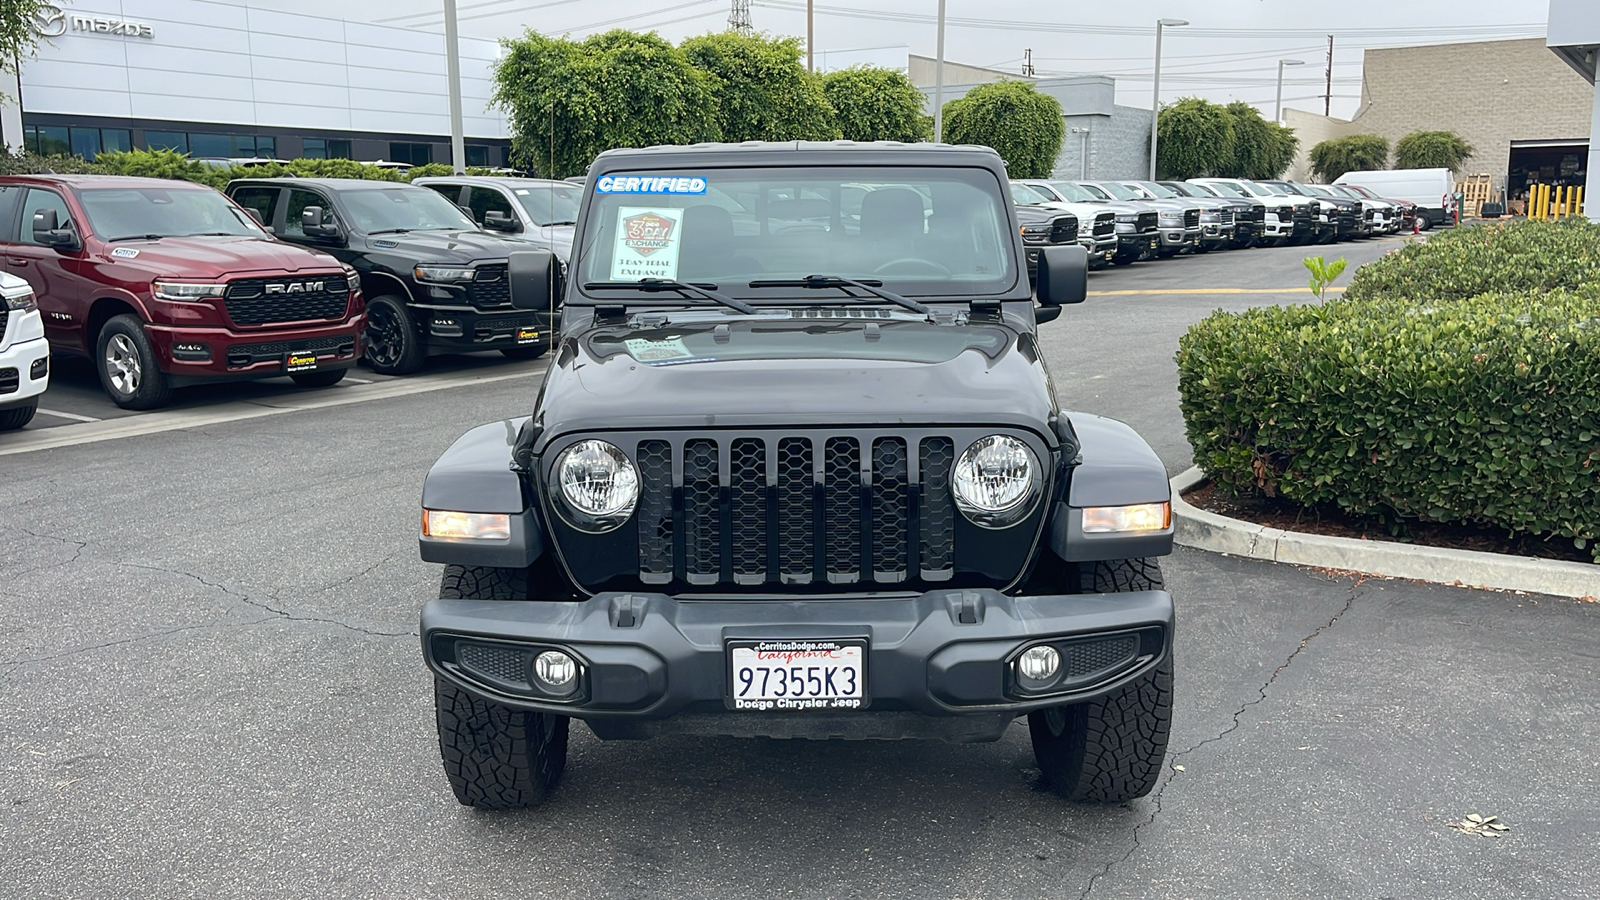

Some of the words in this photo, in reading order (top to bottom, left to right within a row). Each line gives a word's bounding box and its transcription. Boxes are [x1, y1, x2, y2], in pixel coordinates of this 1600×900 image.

[598, 177, 706, 193] CERTIFIED
[644, 227, 669, 237] DAY
[265, 281, 324, 294] RAM
[759, 642, 835, 652] CerritosDodge.com
[757, 650, 841, 664] California
[739, 667, 856, 697] 97355K3
[735, 699, 774, 710] Dodge
[776, 698, 828, 710] Chrysler
[831, 698, 861, 709] Jeep
